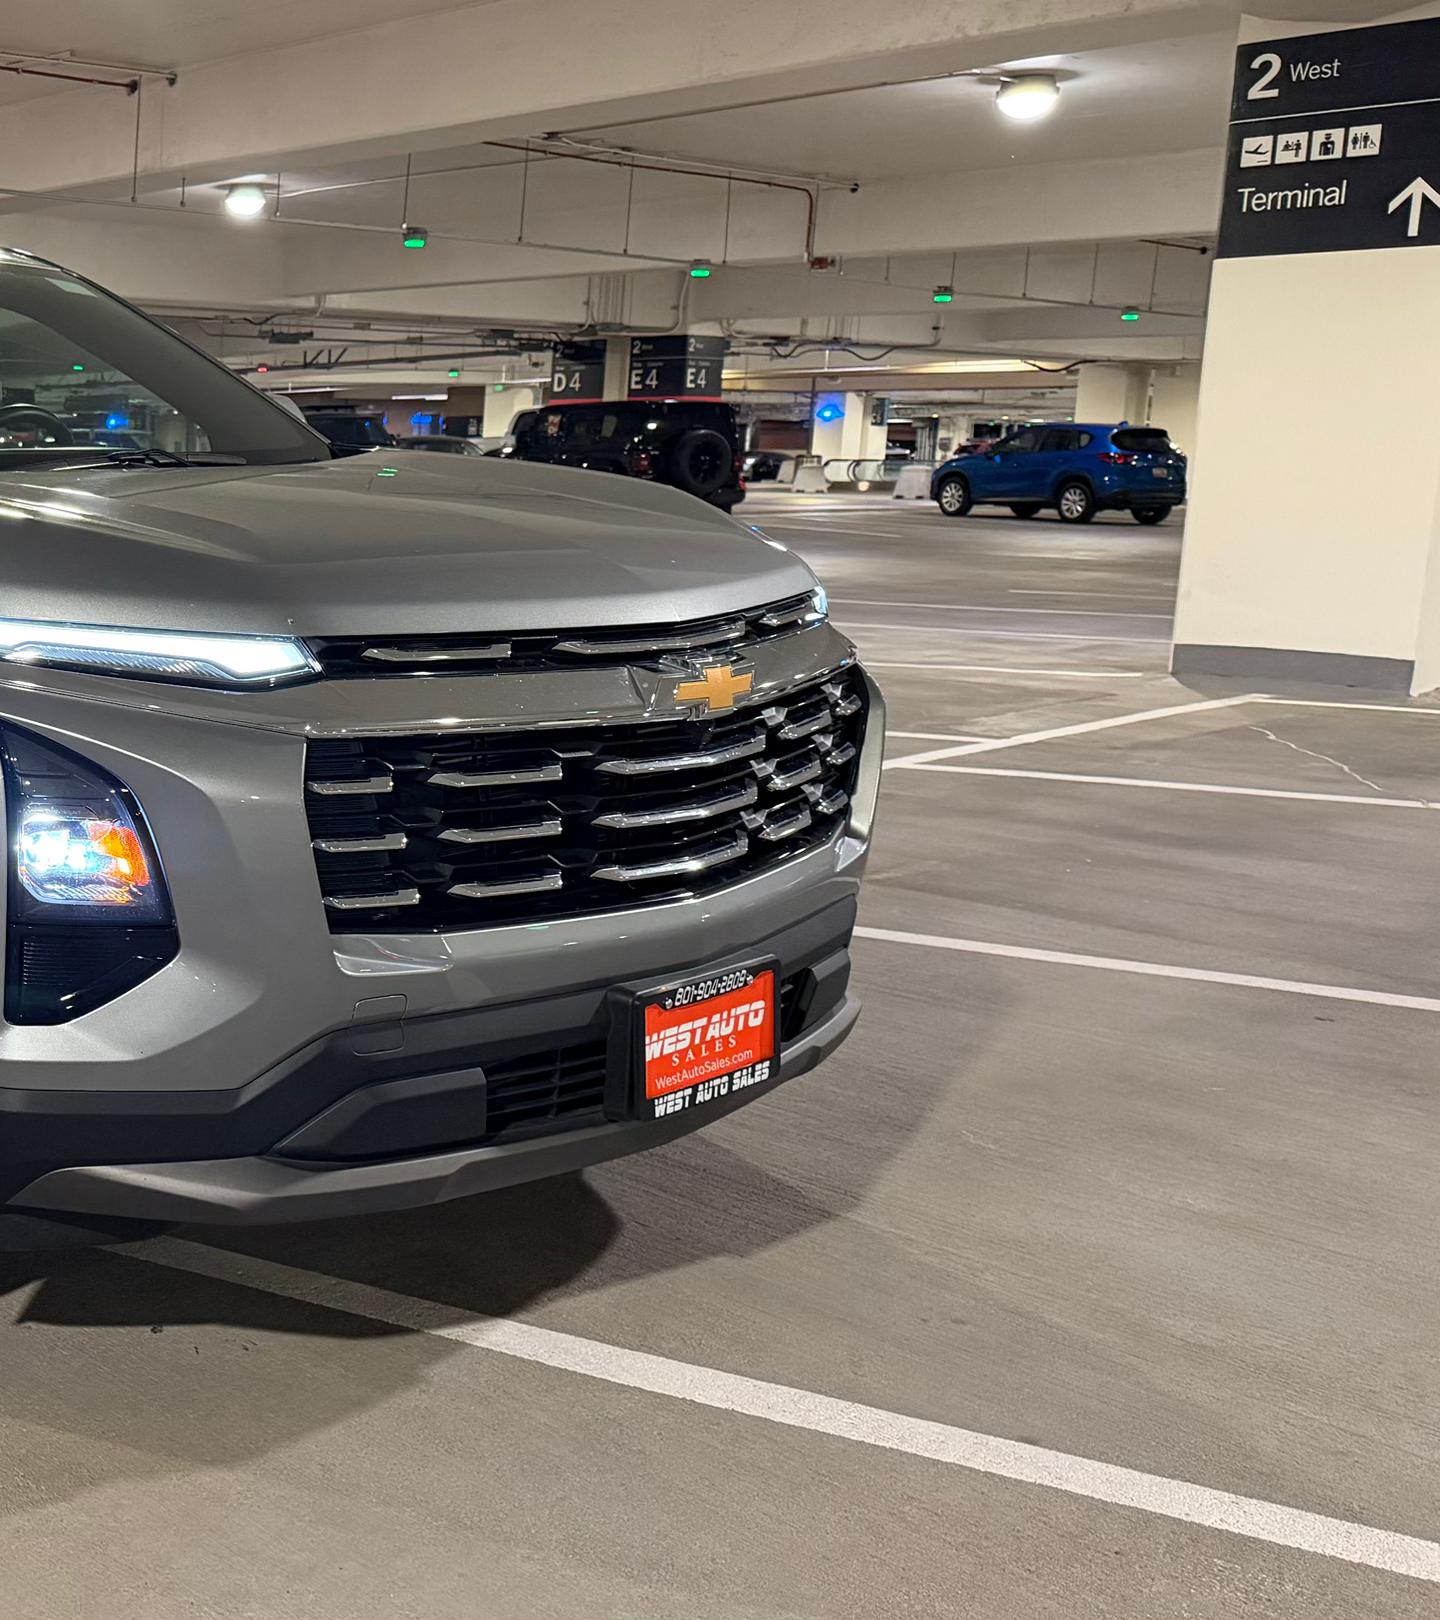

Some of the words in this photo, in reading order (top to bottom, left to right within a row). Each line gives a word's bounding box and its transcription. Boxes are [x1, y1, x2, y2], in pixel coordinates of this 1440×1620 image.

[1246, 52, 1283, 101] 2
[1289, 58, 1342, 83] West
[1237, 180, 1348, 213] Terminal
[632, 339, 641, 354] 2
[688, 338, 696, 352] 2
[674, 969, 747, 1007] 801-904-2809
[671, 1034, 737, 1067] SALES
[655, 1049, 753, 1090] WestAutoSales.com
[654, 1087, 693, 1118] WEST
[695, 1075, 729, 1104] AUTO
[732, 1060, 771, 1092] SALES
